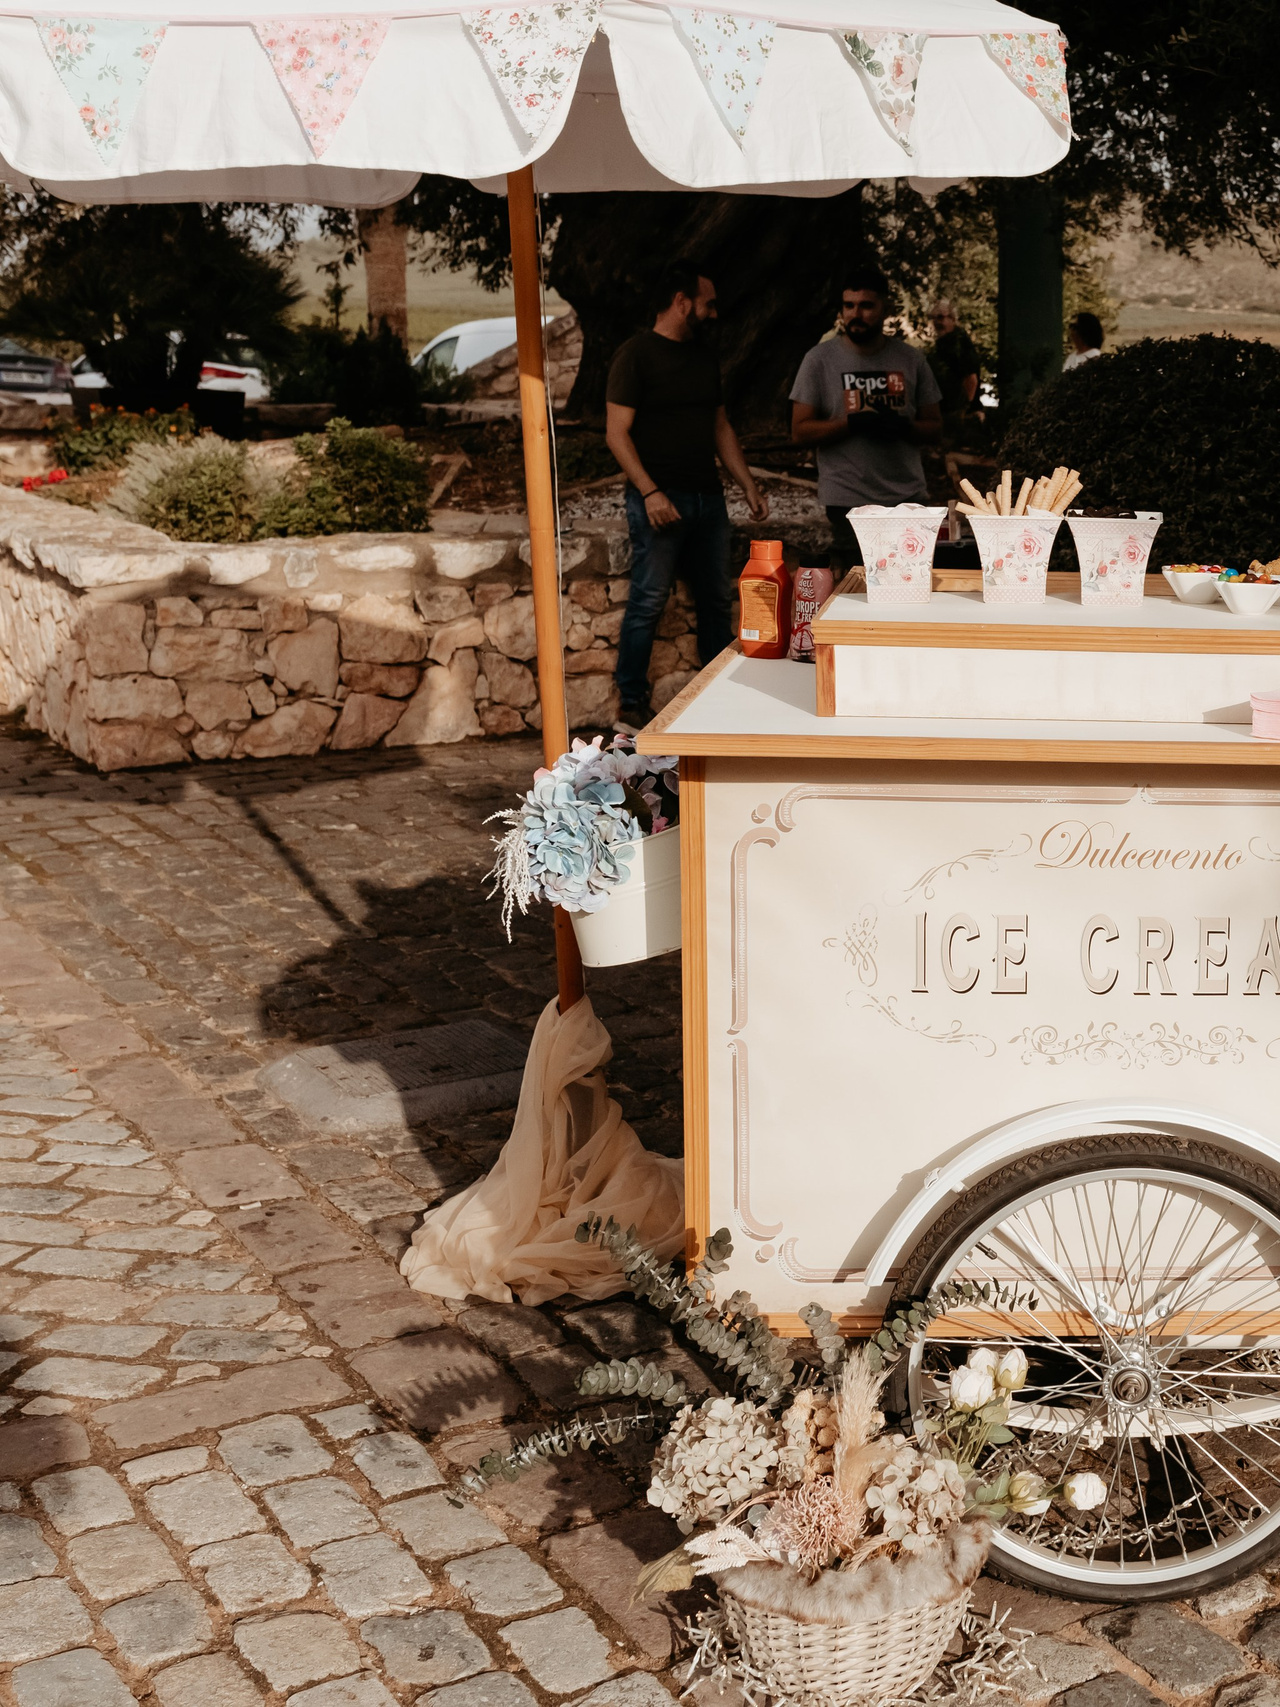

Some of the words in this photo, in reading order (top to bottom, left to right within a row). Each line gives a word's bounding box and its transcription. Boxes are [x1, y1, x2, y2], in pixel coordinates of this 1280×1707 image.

[843, 373, 888, 395] Pepe
[796, 600, 820, 613] SIROPE
[1034, 820, 1246, 870] Dulcevento
[911, 911, 1029, 995] ICE
